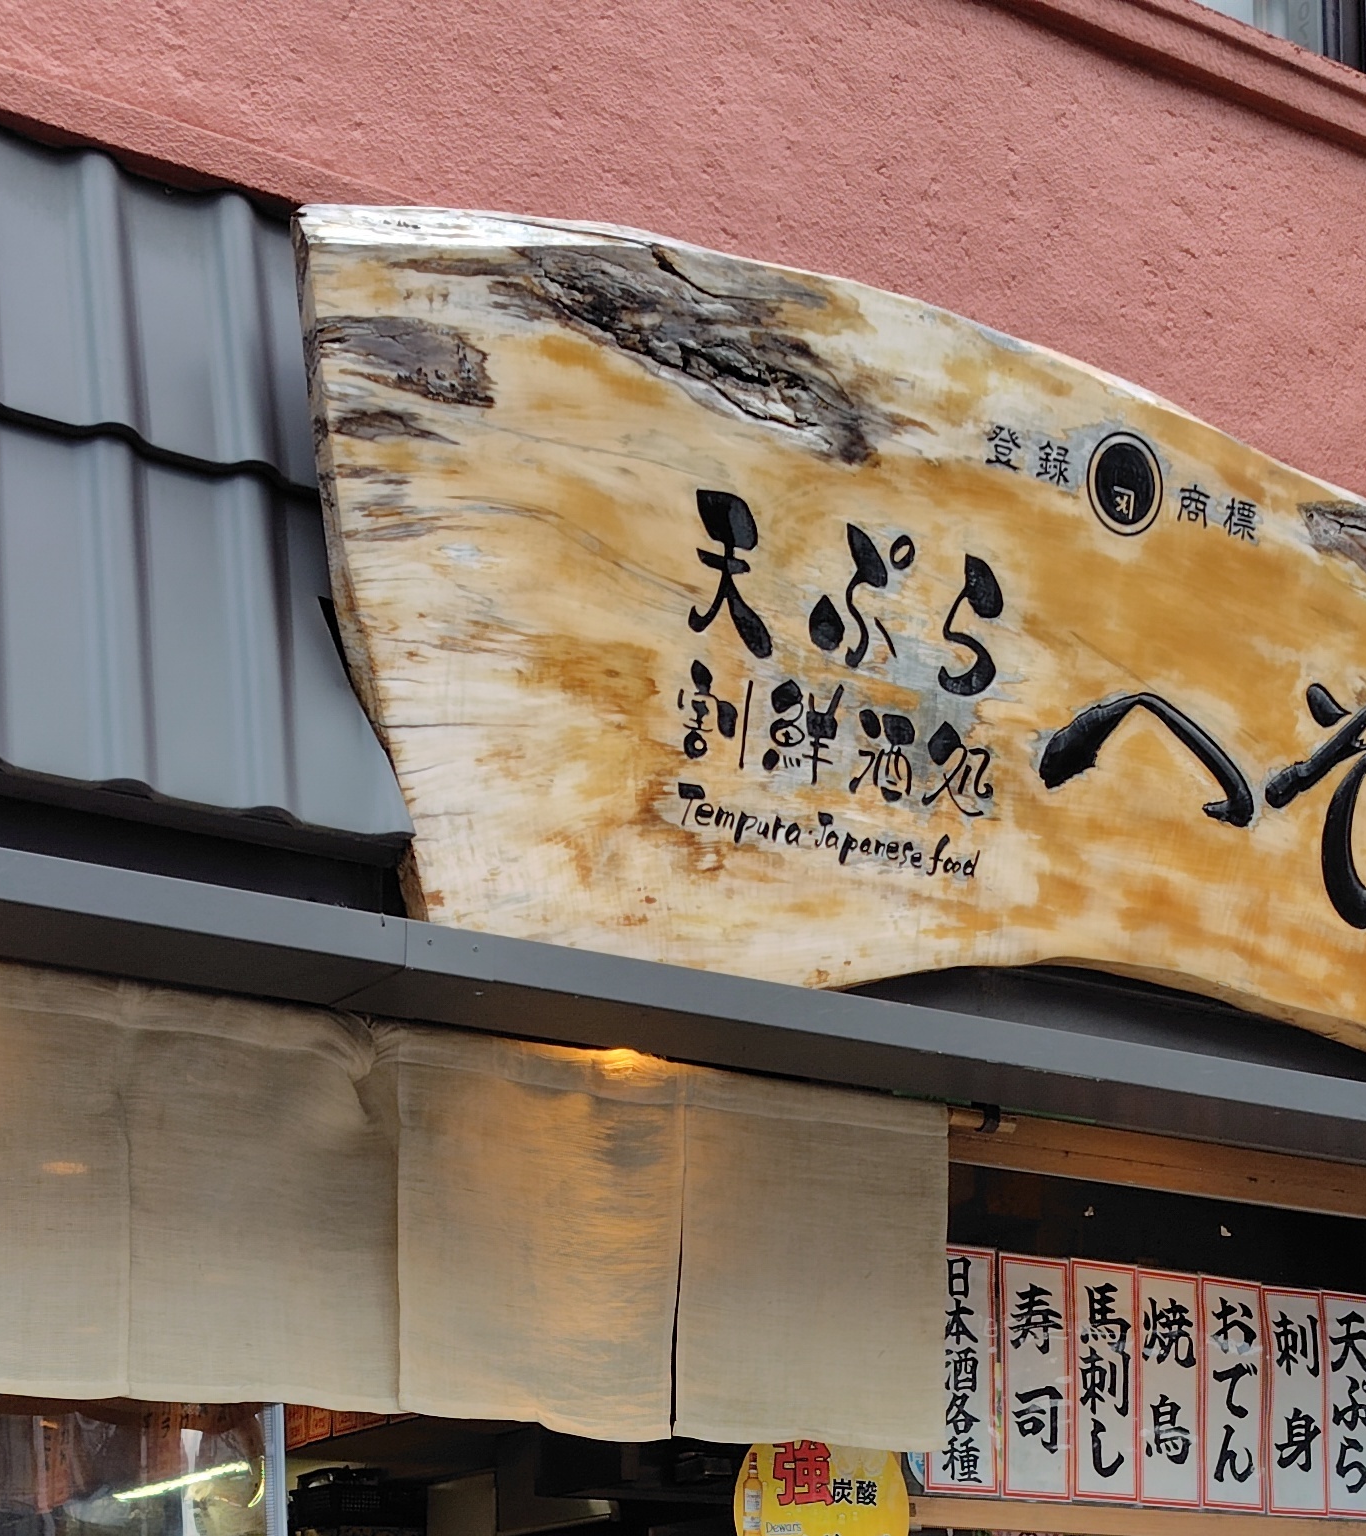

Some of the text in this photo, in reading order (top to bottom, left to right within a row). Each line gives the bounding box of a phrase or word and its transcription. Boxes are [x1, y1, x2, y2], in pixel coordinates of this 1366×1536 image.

[984, 425, 1071, 487] 登録
[1176, 485, 1258, 541] 商標
[688, 489, 1005, 696] 天ぷら
[927, 840, 980, 880] food
[1010, 1283, 1064, 1454] 寿司
[1077, 1283, 1131, 1478] 馬刺し
[1142, 1297, 1197, 1465] 焼鳥
[1212, 1296, 1259, 1484] おでん
[1273, 1313, 1322, 1473] 刺身
